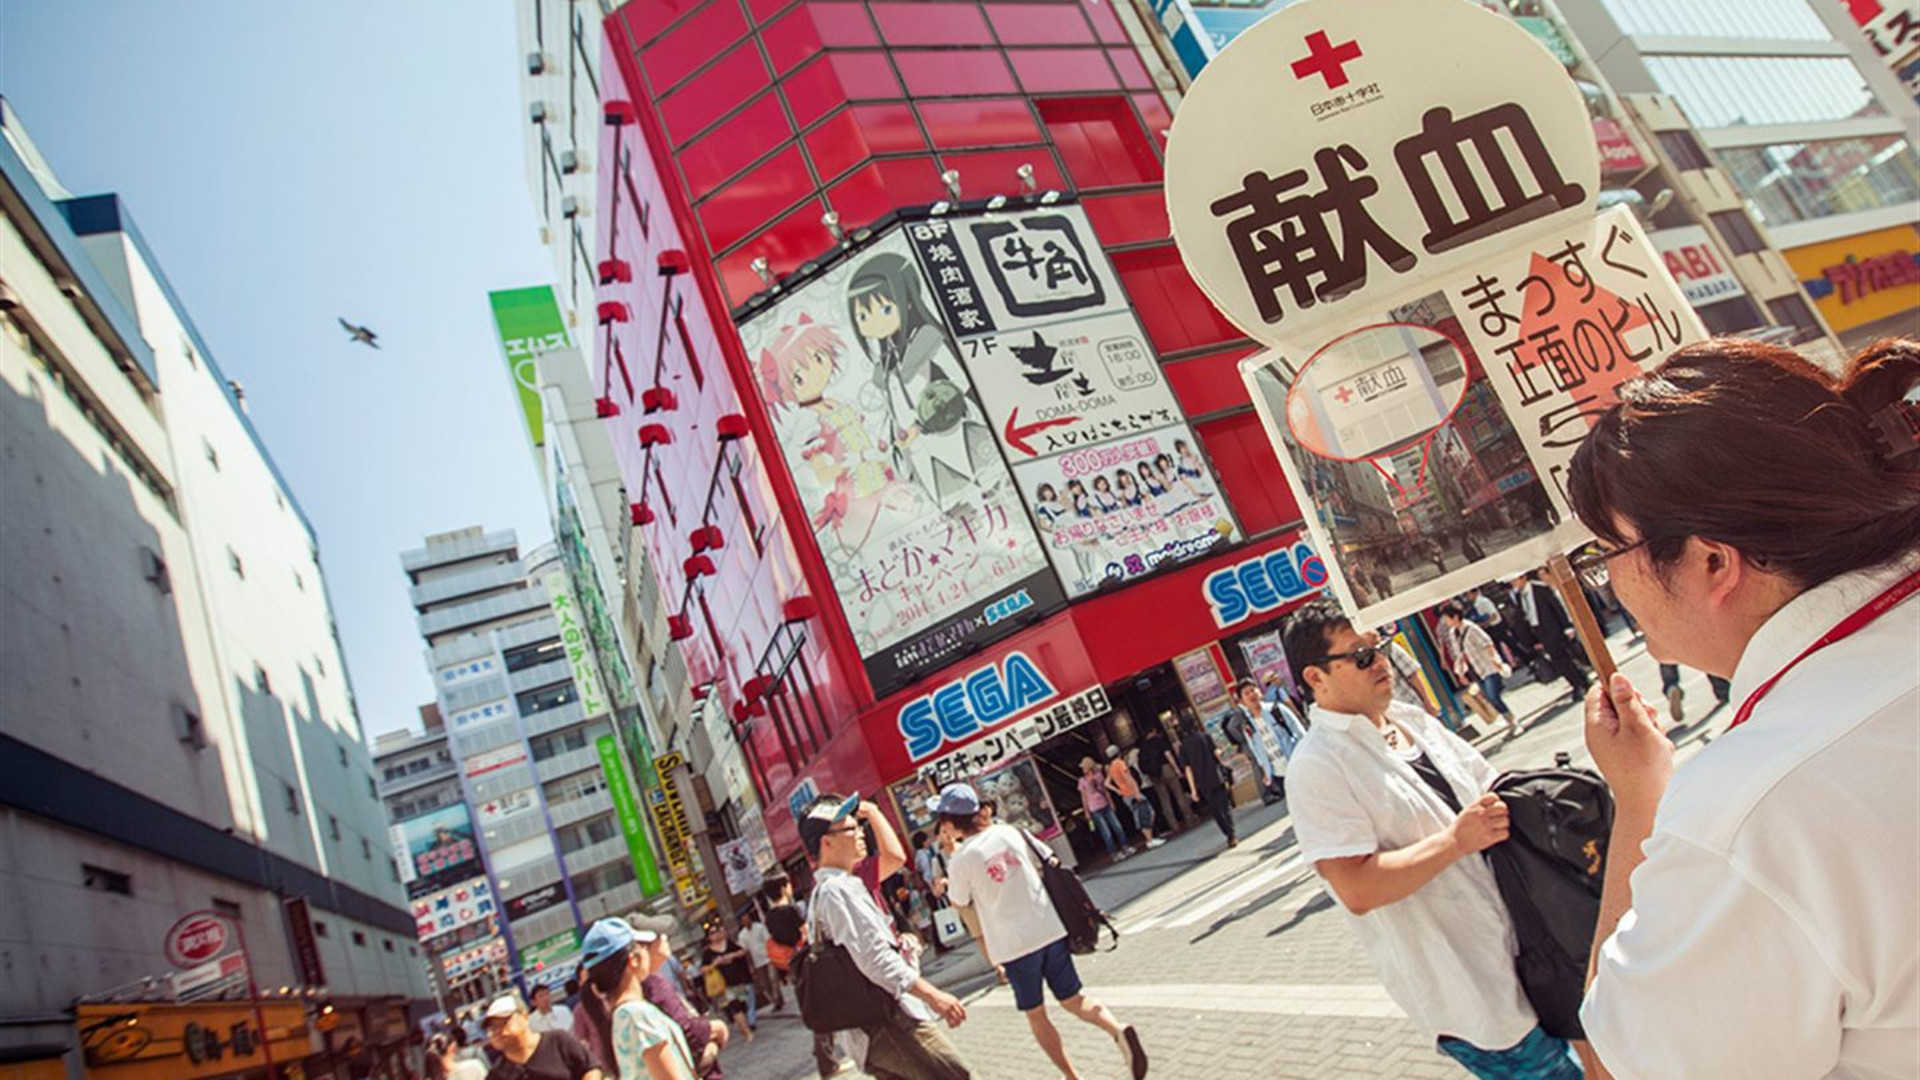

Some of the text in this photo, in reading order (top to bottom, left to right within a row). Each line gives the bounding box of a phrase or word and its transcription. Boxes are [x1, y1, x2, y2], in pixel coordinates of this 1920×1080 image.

[913, 219, 949, 241] 8F
[1211, 102, 1586, 324] 献血
[928, 243, 986, 329] 焼肉酒家
[1001, 236, 1088, 289] 牛角
[1461, 225, 1648, 337] まっすぐ
[962, 336, 997, 358] 7F
[1494, 292, 1683, 407] 正面のビル
[1354, 364, 1407, 398] 献血
[1036, 395, 1117, 421] DOMA-DOMA
[1046, 409, 1179, 451] 入口はこちらです。
[901, 552, 979, 603] キャンペーン
[984, 589, 1034, 627] SEGA
[897, 650, 1060, 763] SEGA
